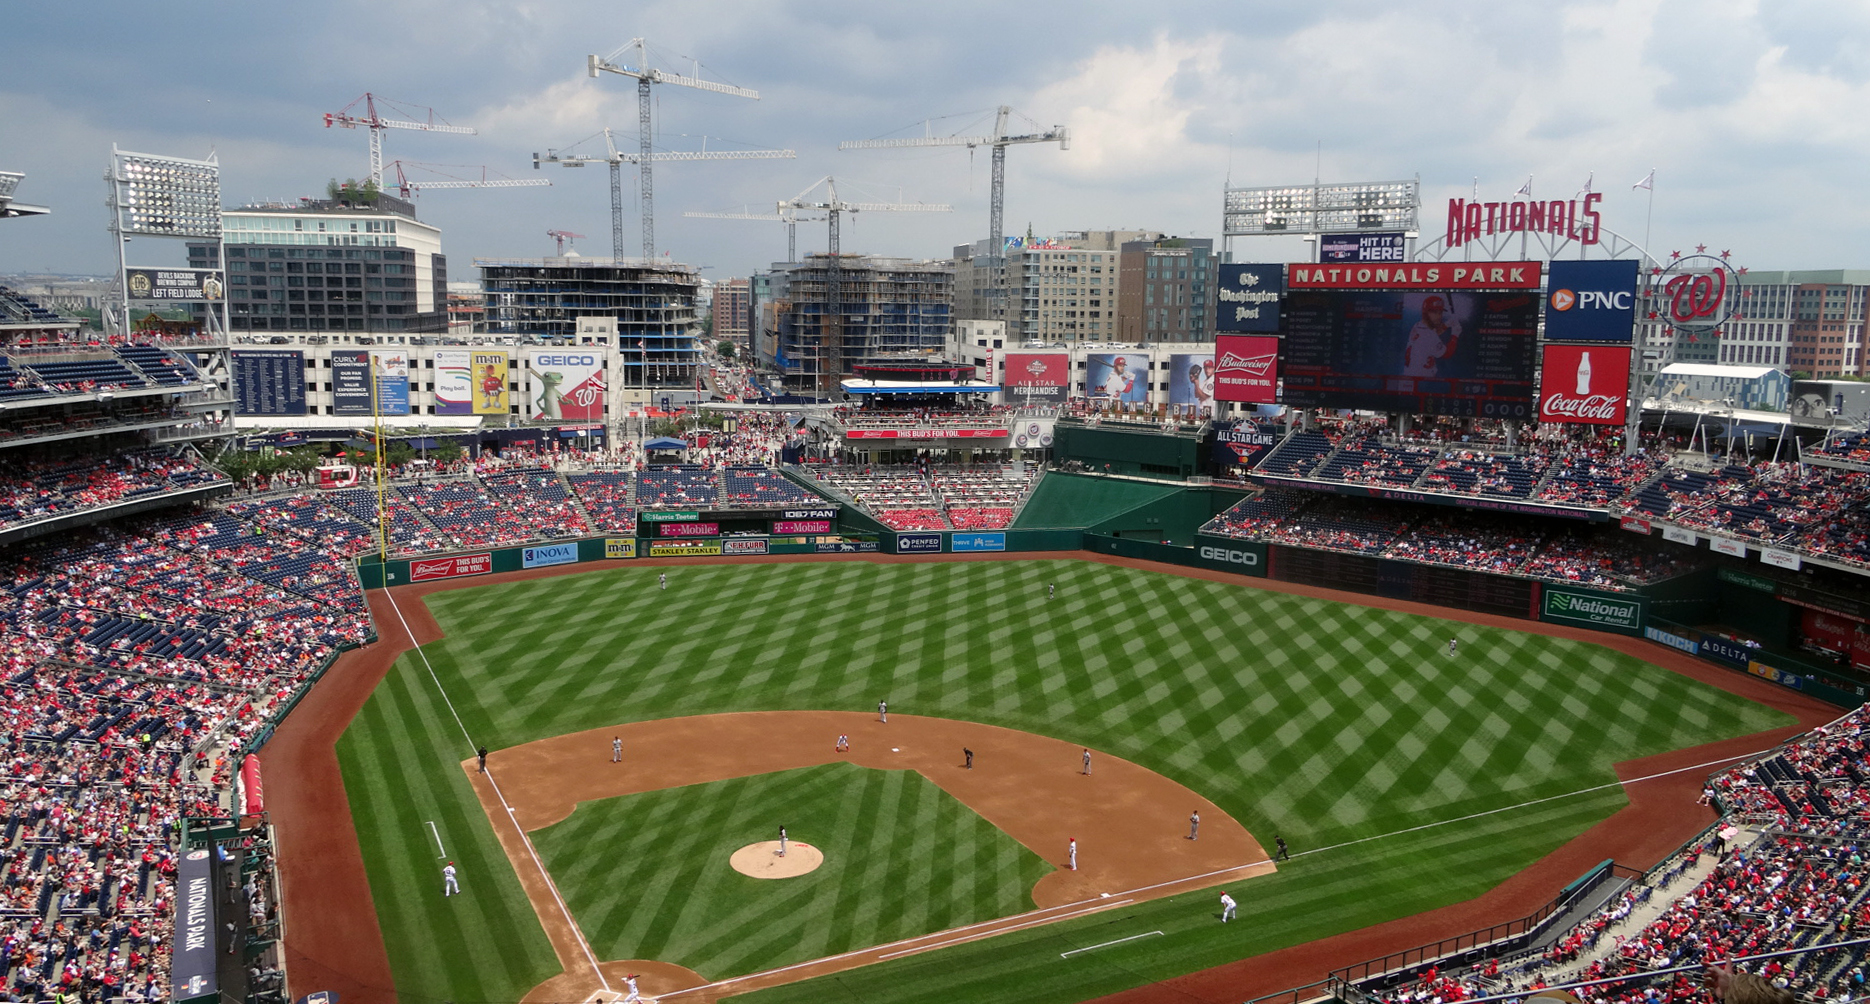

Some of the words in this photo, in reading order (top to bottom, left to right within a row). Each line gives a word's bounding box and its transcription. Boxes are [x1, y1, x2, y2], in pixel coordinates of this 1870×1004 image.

[1446, 192, 1602, 248] NATIONALS
[1360, 237, 1379, 247] HIT
[1381, 237, 1393, 246] IT
[1359, 246, 1403, 260] HERE
[1239, 272, 1259, 287] The
[1296, 268, 1440, 283] NATIONALS
[1453, 267, 1526, 283] PARK
[153, 289, 167, 298] LEFT
[168, 289, 184, 298] FIELD
[185, 289, 203, 298] LODGE
[1219, 287, 1278, 305] Washington
[1578, 290, 1631, 310] PNC
[1665, 266, 1727, 322] W
[1235, 307, 1259, 322] Post
[537, 355, 594, 366] GEICO
[1220, 356, 1270, 369] Budweiser
[1088, 400, 1152, 413] SWING
[1485, 403, 1494, 414] 0
[1499, 404, 1509, 415] 0
[1514, 405, 1524, 416] 0
[1543, 392, 1621, 419] Coca-Cola
[1217, 431, 1231, 441] ALL
[1231, 432, 1251, 443] STAR
[1252, 433, 1273, 445] GAME
[1394, 492, 1425, 501] DELTA
[809, 510, 833, 518] FAN
[1455, 499, 1478, 507] OFFICIAL
[1478, 501, 1499, 509] AIRLINE
[1519, 505, 1556, 515] WASHINGTON
[1557, 508, 1590, 518] NATIONALS.
[471, 555, 490, 564] BUD'S
[536, 547, 570, 558] INOVA
[1200, 545, 1258, 566] GEICO
[1767, 552, 1793, 563] CHAMPIONS
[470, 564, 484, 572] YOU.
[1727, 573, 1750, 585] Harris
[1751, 579, 1774, 592] Teeter
[1781, 587, 1797, 597] 12:16
[1569, 597, 1634, 618] National
[1781, 596, 1805, 607] WASHINGTON
[1805, 602, 1826, 613] NATIONALS
[1826, 608, 1840, 616] DREAM
[1840, 611, 1866, 623] FOUNDATION
[1590, 613, 1604, 621] Car
[1604, 615, 1630, 625] Rental
[1658, 630, 1694, 653] KOCH
[1712, 643, 1747, 662] DELTA
[187, 876, 207, 926] NATIONALS
[185, 926, 205, 952] PARK
